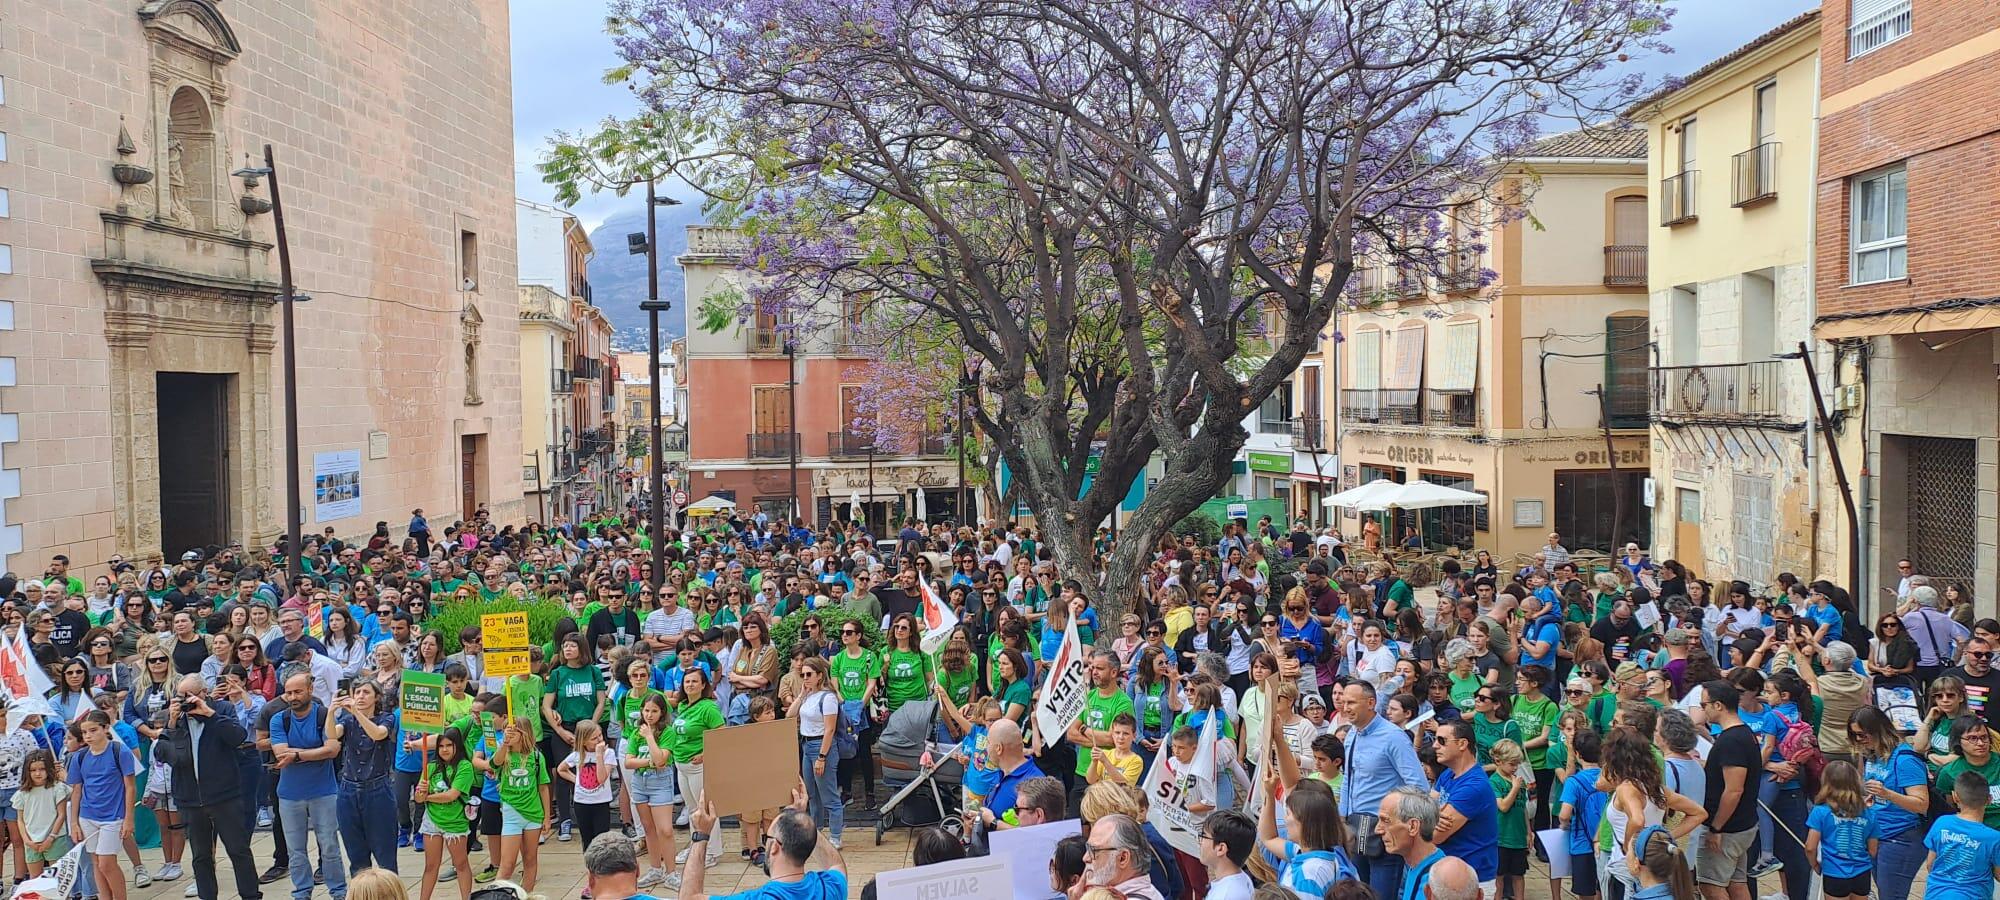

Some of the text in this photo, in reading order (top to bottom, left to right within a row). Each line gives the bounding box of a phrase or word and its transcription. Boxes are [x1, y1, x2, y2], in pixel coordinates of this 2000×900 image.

[1387, 445, 1434, 465] ORIGEN
[484, 615, 525, 627] 23 VAGA
[414, 686, 430, 694] PER
[404, 693, 439, 703] L'ESCOLA
[405, 700, 437, 711] PÚBLICA
